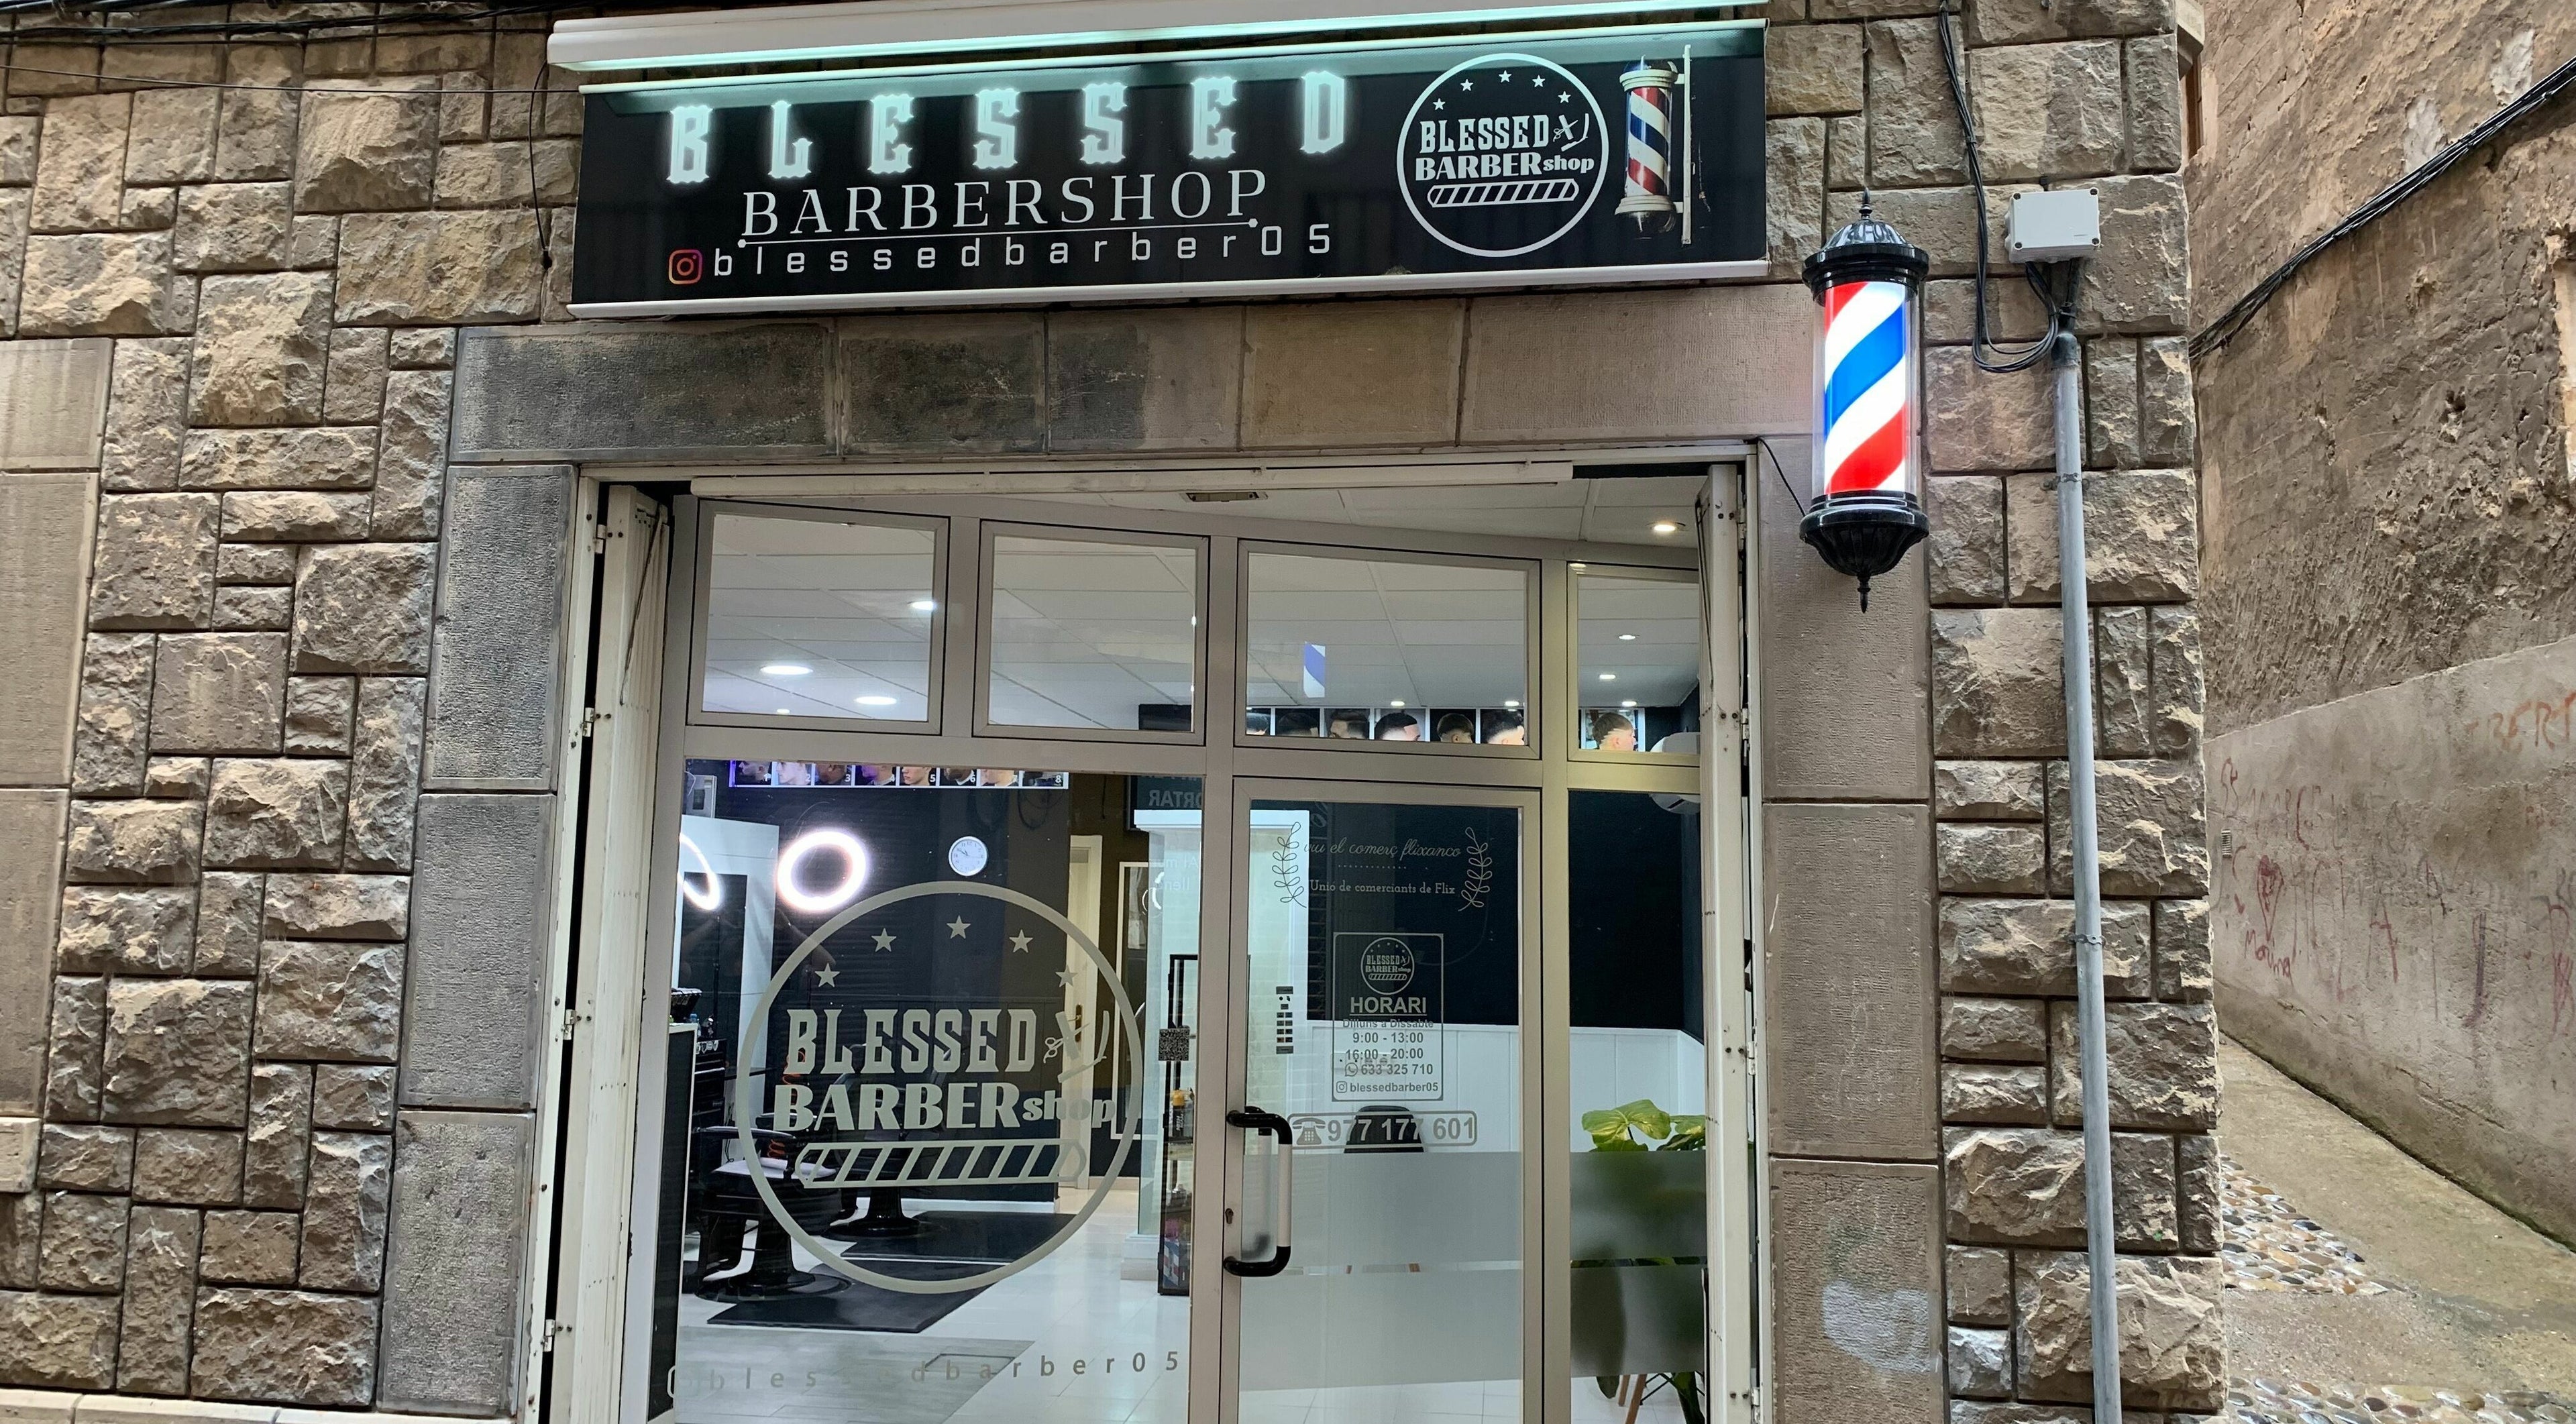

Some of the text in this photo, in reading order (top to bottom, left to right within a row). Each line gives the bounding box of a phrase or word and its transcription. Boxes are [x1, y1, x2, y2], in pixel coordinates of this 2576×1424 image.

[666, 69, 1346, 184] BLESSED
[1419, 114, 1549, 154] BLESSED
[741, 168, 1267, 236] BARBERSHOP
[714, 223, 1331, 277] blessedbarber05
[1349, 843, 1398, 859] comerç
[1310, 880, 1456, 895] Unió de comerciants de Flix
[1366, 954, 1400, 965] BLESSED
[1350, 997, 1427, 1014] HORARI
[1342, 1019, 1378, 1028] Dilluns
[1390, 1019, 1434, 1028] Dissabte
[784, 1009, 1037, 1074] BLESSED
[1352, 1032, 1379, 1043] 9:00
[1391, 1032, 1424, 1043] 13:00
[1346, 1049, 1379, 1060] 16:00
[1391, 1048, 1424, 1059] 20:00
[1361, 1064, 1433, 1075] 633 325 710
[1350, 1082, 1438, 1092] blessedbarber05
[1328, 1117, 1473, 1142] 977 177 601
[710, 1351, 1179, 1391] blesdbarber05
